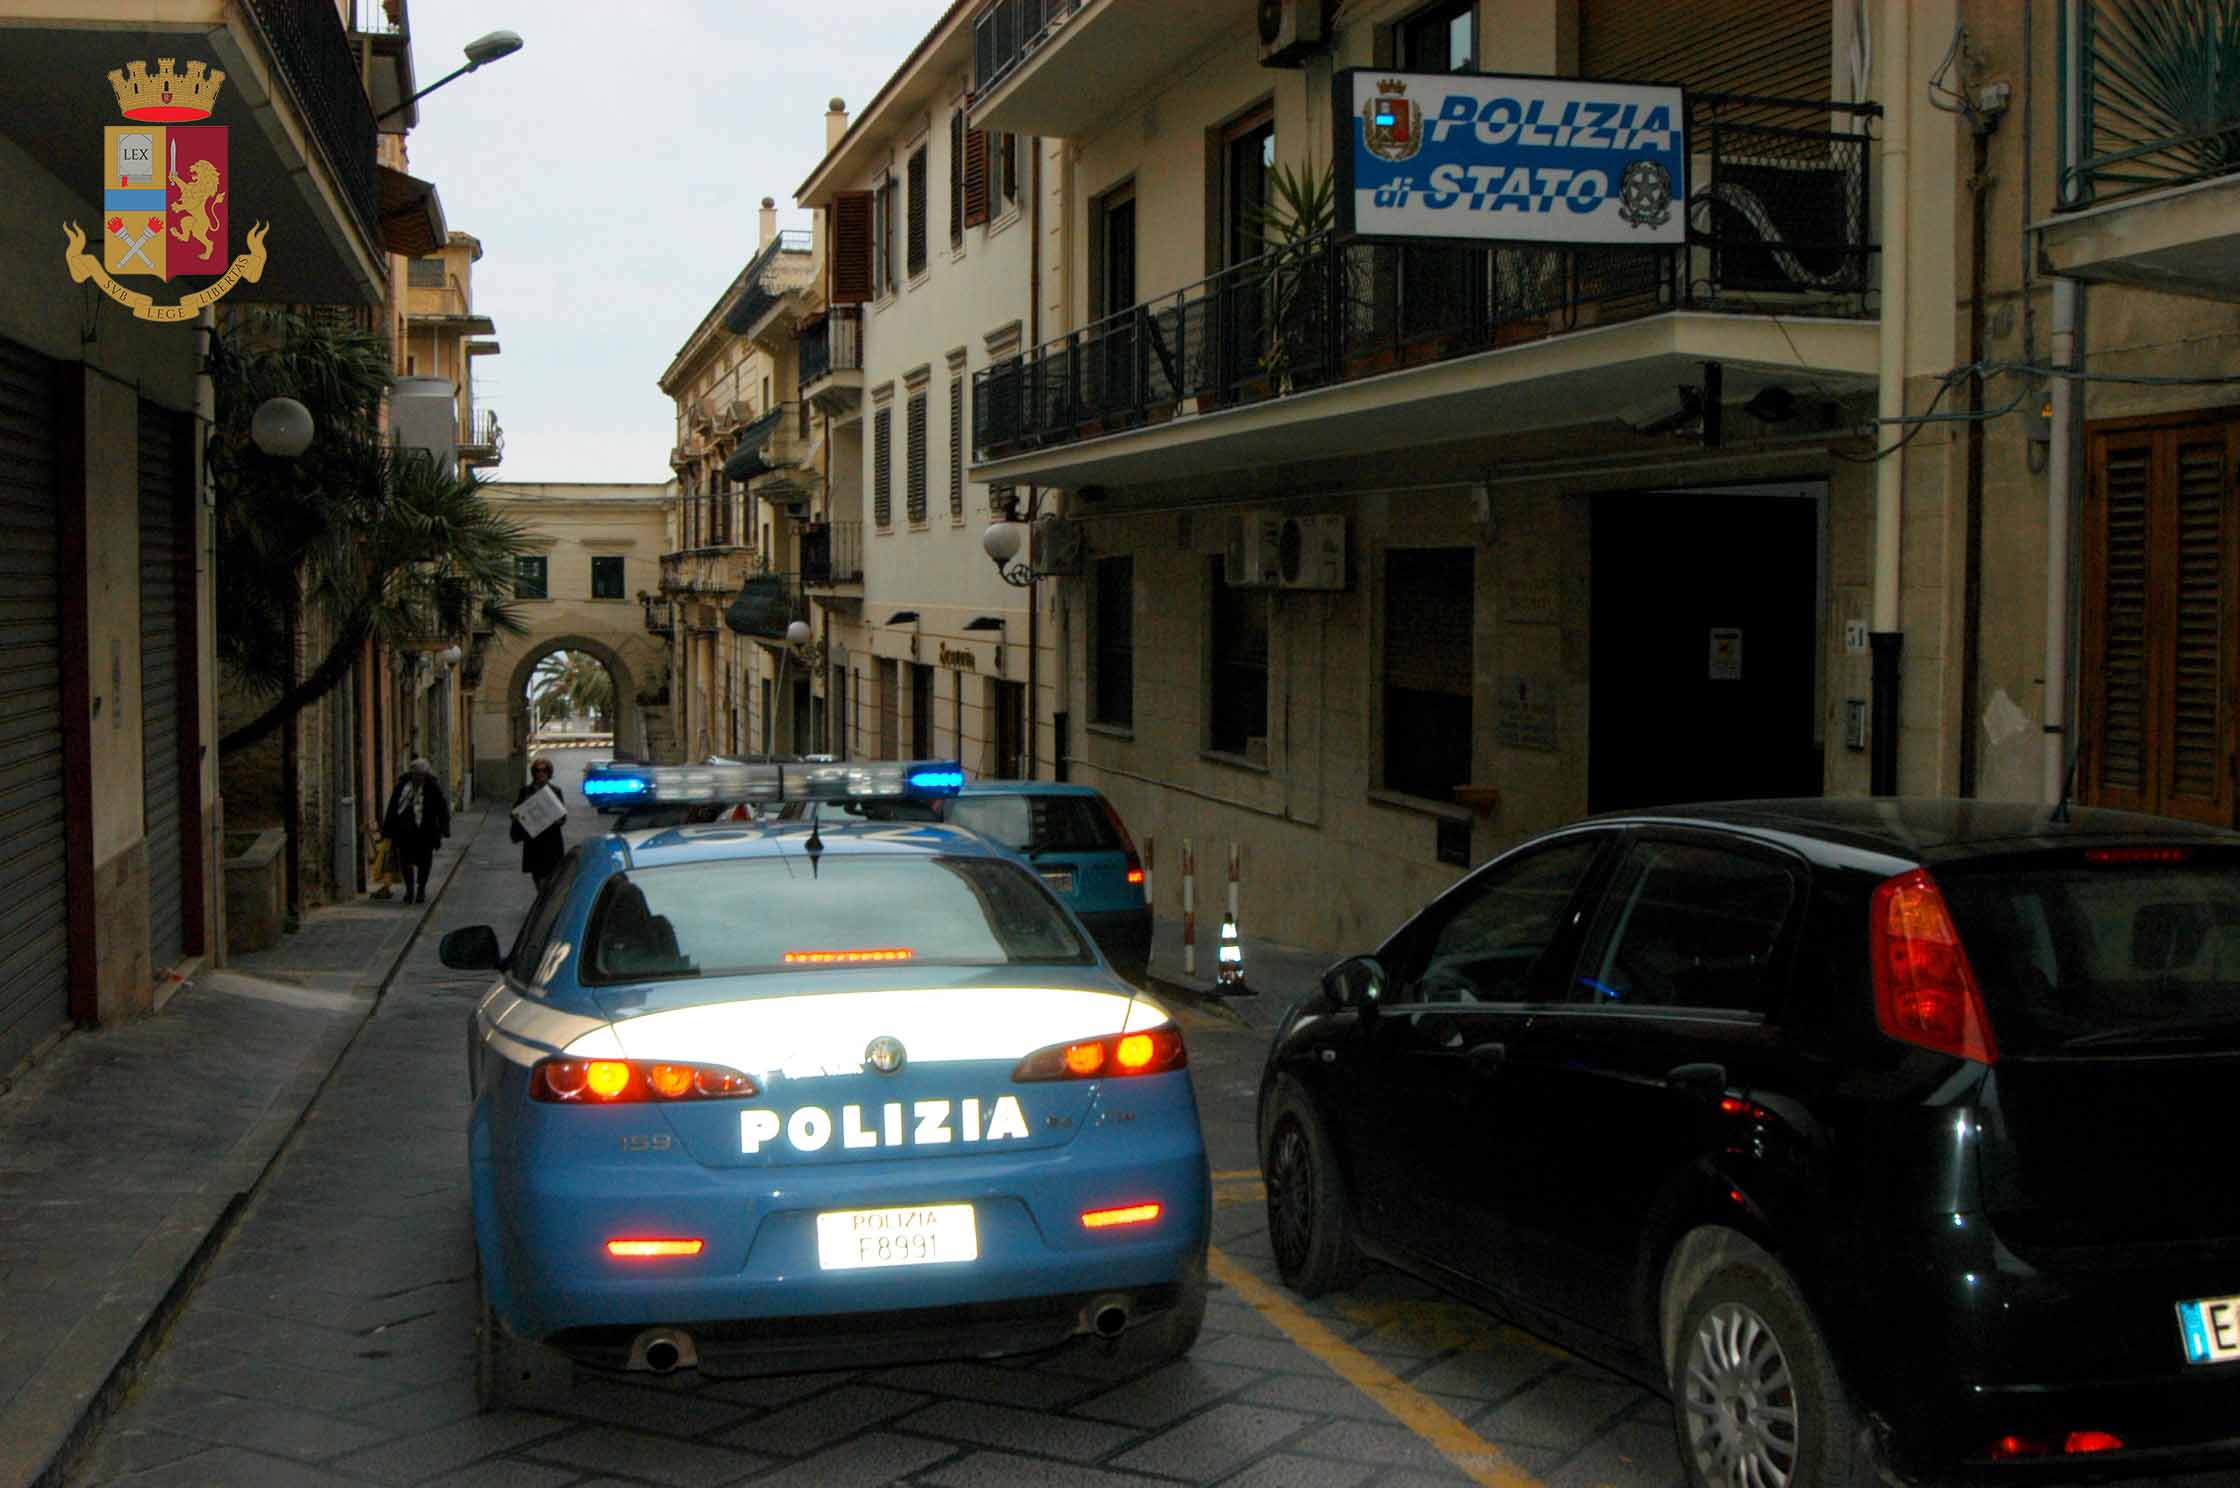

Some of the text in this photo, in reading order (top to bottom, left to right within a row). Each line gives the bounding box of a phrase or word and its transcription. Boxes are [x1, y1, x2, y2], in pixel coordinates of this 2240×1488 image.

[1432, 96, 1671, 151] POLIZIA
[1374, 164, 1609, 215] di STATO
[740, 1096, 1030, 1154] POLIZIA
[852, 1211, 938, 1233] POLIZIA
[859, 1233, 937, 1263] F8991
[2210, 1304, 2240, 1350] E
